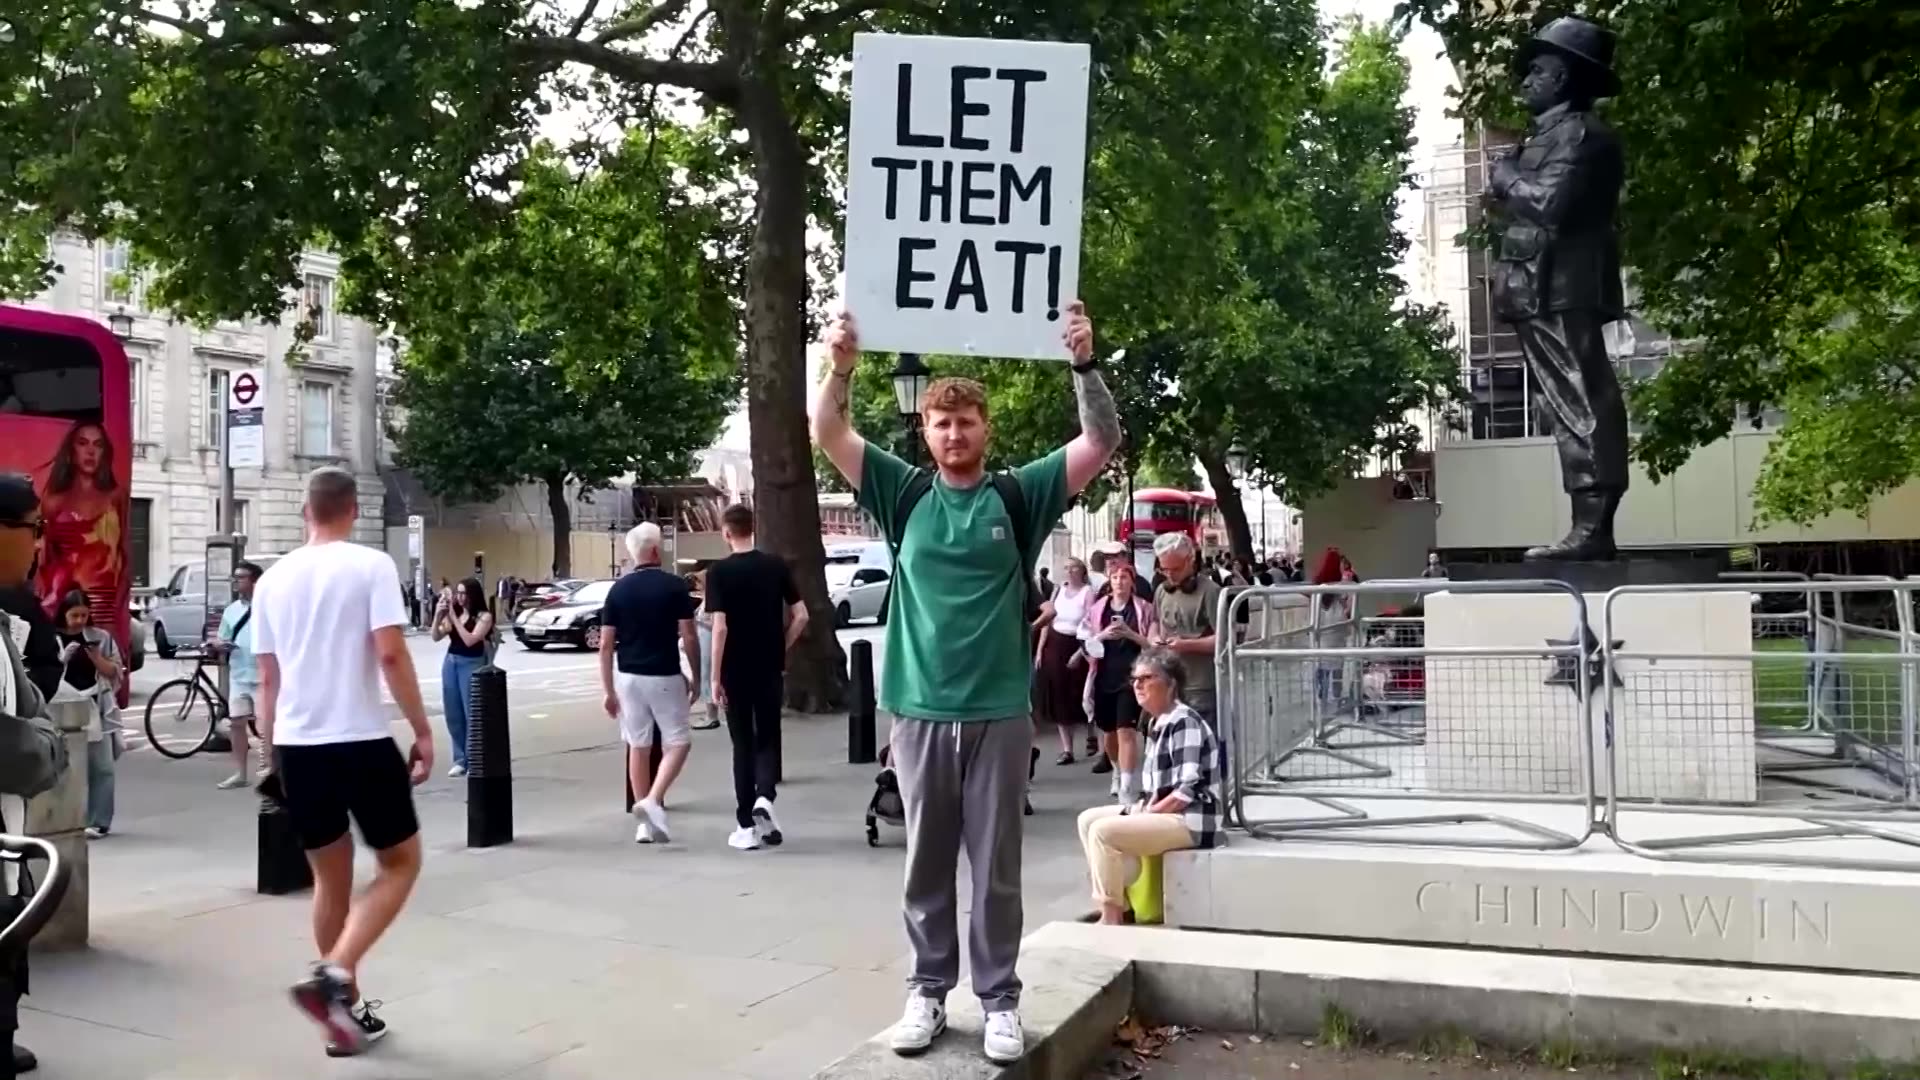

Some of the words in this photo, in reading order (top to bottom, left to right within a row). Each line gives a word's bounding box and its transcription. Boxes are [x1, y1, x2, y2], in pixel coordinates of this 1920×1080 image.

[896, 63, 1047, 153] LET
[871, 156, 1053, 227] THEM
[895, 237, 1062, 322] EAT!
[1415, 879, 1832, 945] CHINDWIN
